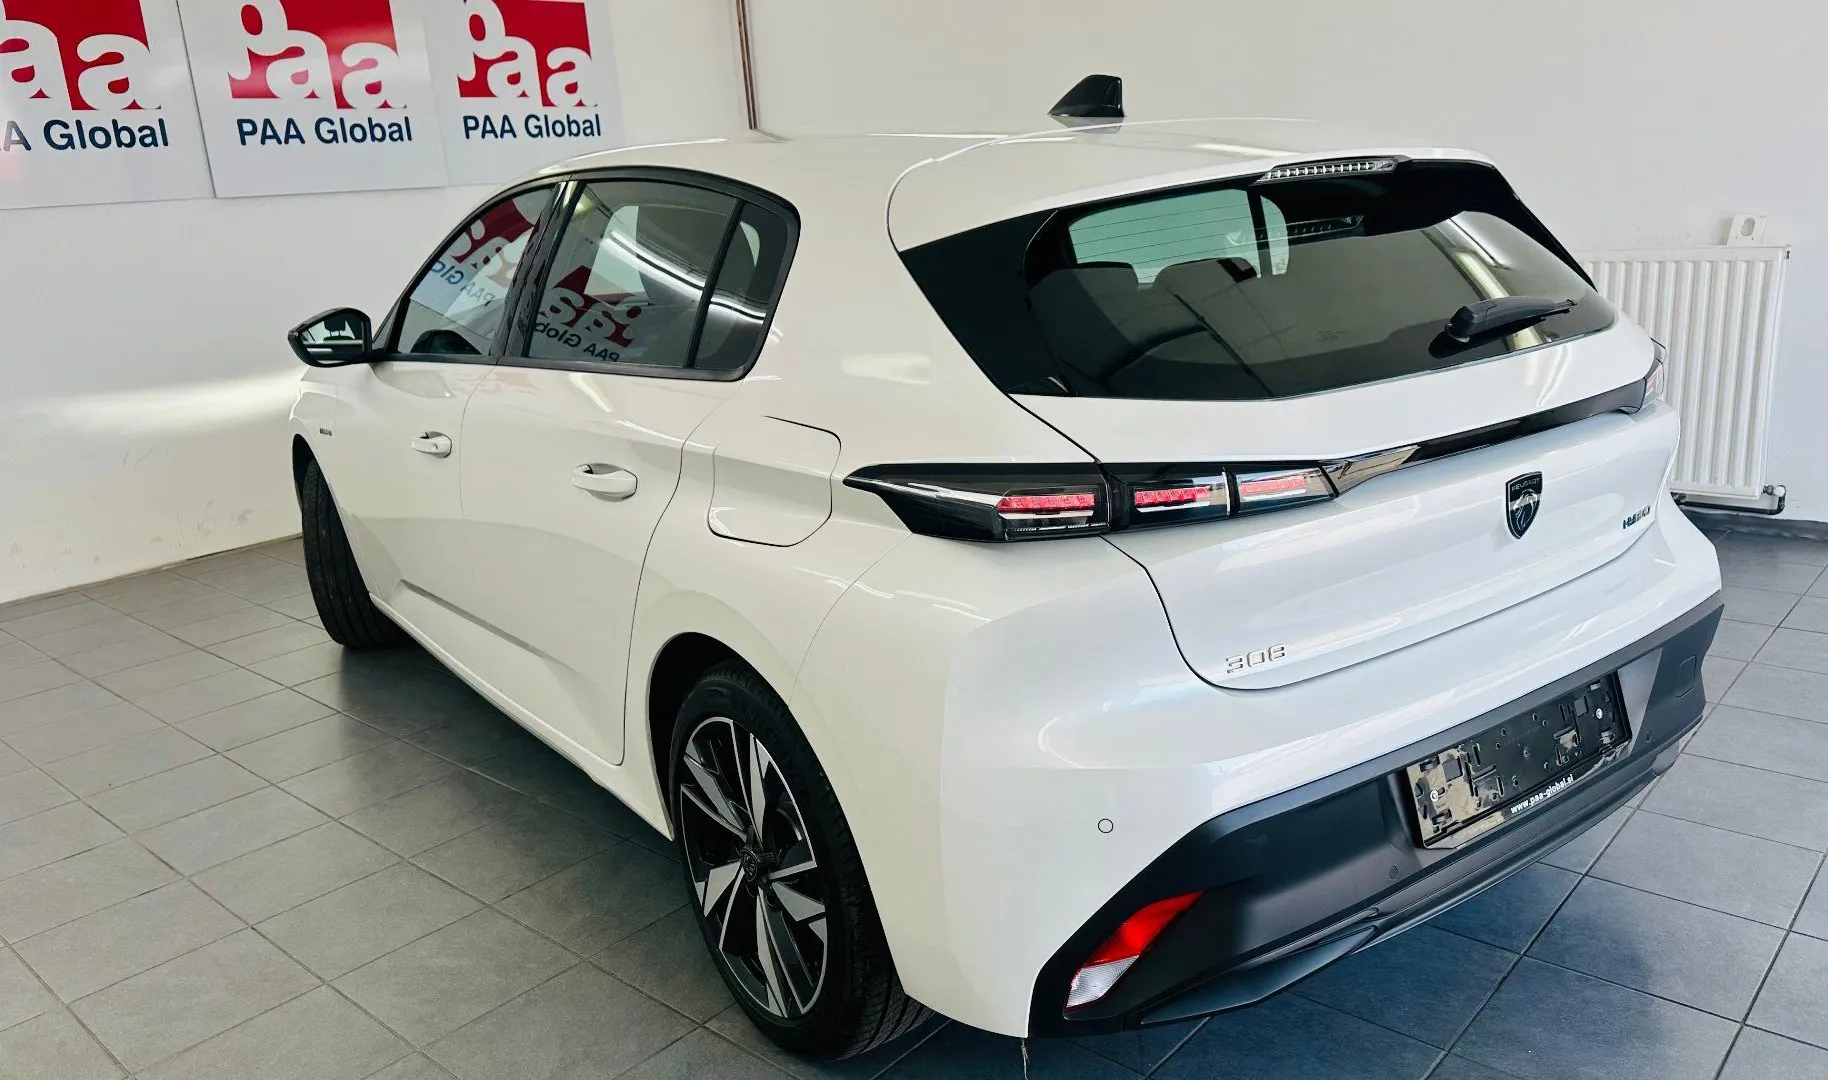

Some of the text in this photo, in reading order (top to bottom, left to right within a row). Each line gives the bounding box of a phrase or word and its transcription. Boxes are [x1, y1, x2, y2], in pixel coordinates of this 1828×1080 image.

[0, 117, 169, 152] A Global
[236, 115, 412, 146] PAA Global
[462, 113, 601, 140] PAA Global
[1225, 644, 1286, 674] 308
[1510, 773, 1574, 814] www.paa-global.si
